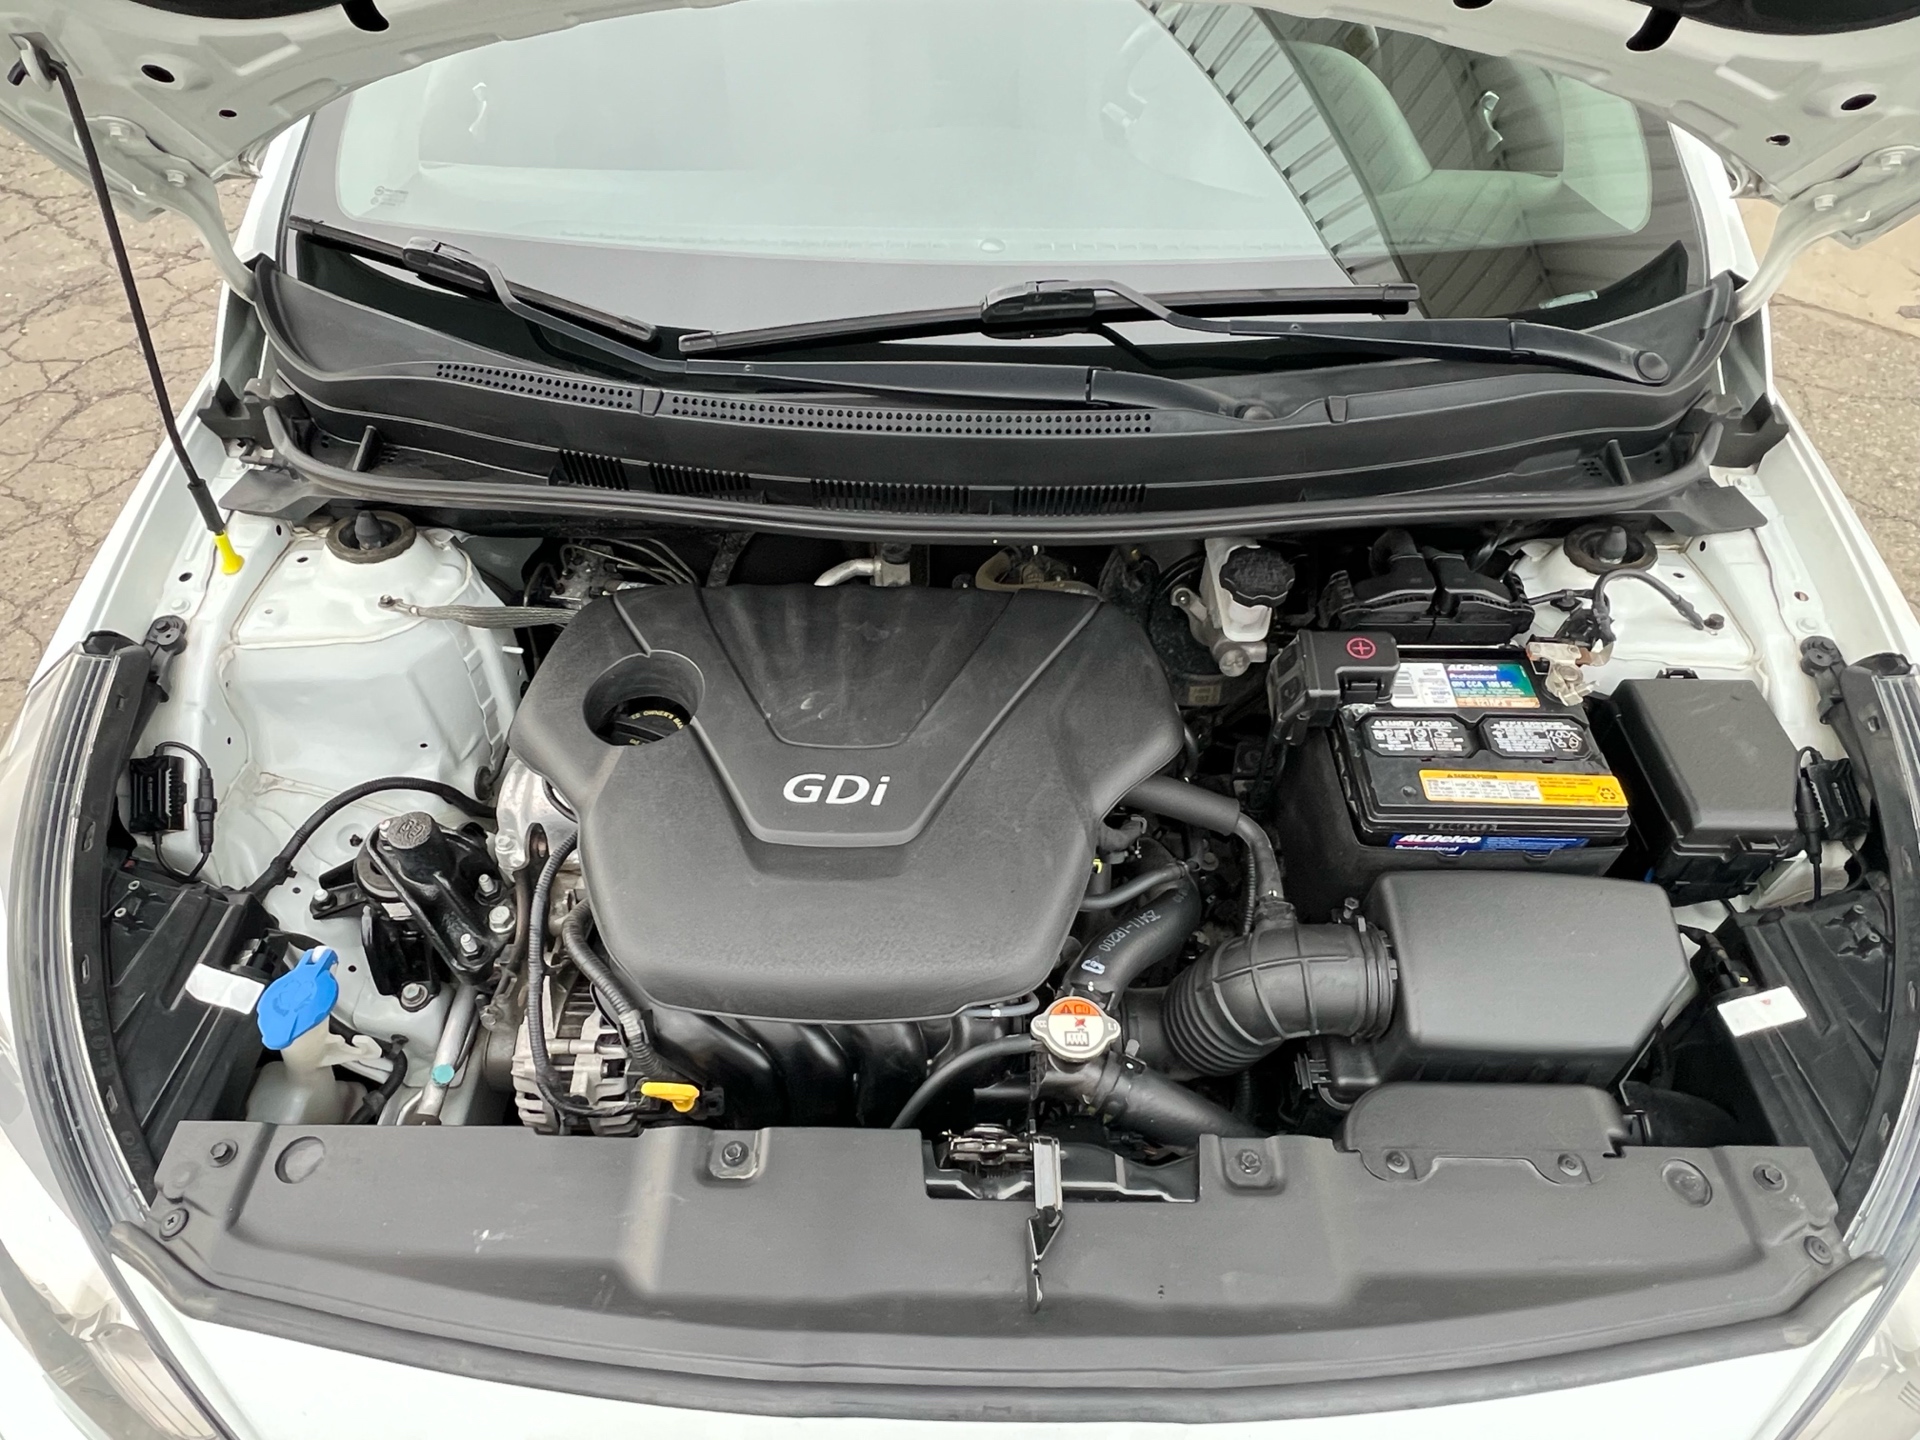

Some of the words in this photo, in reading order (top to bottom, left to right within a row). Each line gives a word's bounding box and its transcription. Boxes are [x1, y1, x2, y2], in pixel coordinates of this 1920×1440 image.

[783, 773, 891, 806] GDi
[1398, 834, 1482, 844] ACDelco
[1395, 844, 1460, 852] Professional
